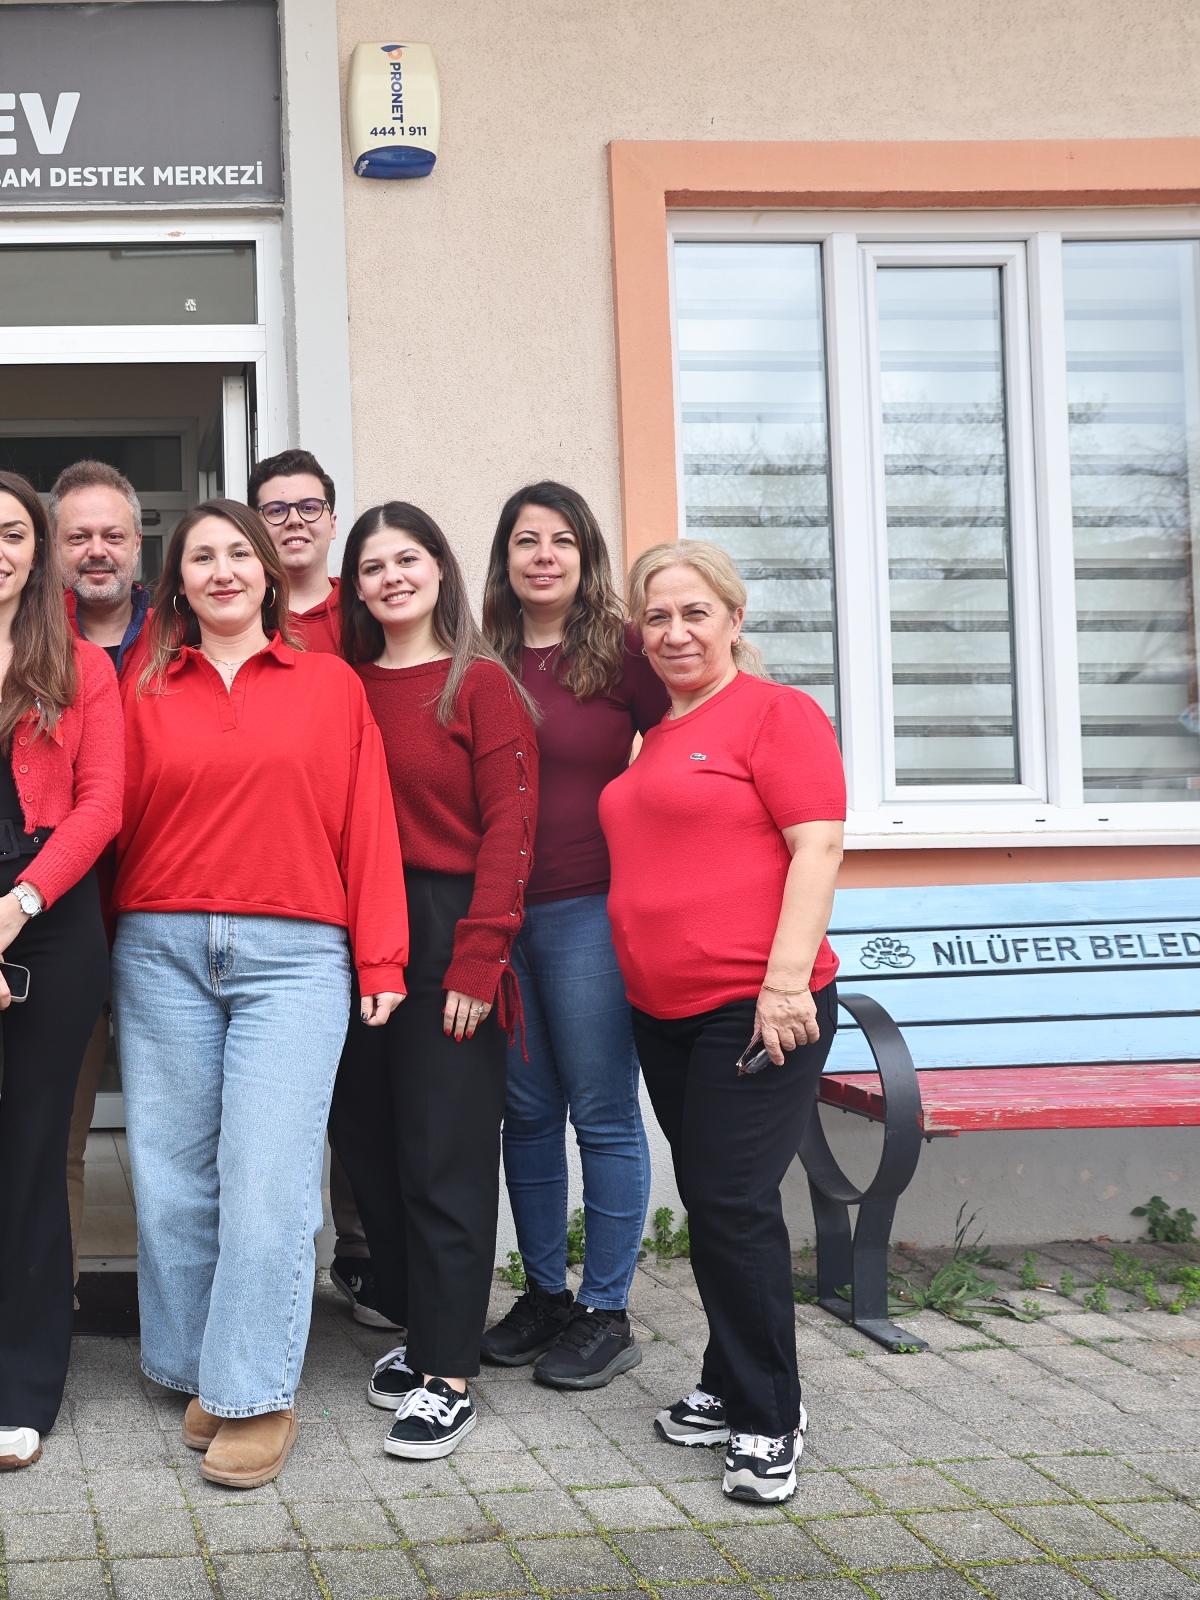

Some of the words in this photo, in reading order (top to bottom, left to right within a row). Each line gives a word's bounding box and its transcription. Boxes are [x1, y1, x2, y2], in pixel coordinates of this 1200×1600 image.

[389, 62, 404, 123] PRONET
[369, 126, 396, 137] 444
[399, 126, 405, 136] 1
[408, 126, 427, 136] 911
[49, 166, 146, 187] DESTEK
[153, 160, 263, 186] MERKEZİ
[932, 934, 1082, 966] NİLÜFER
